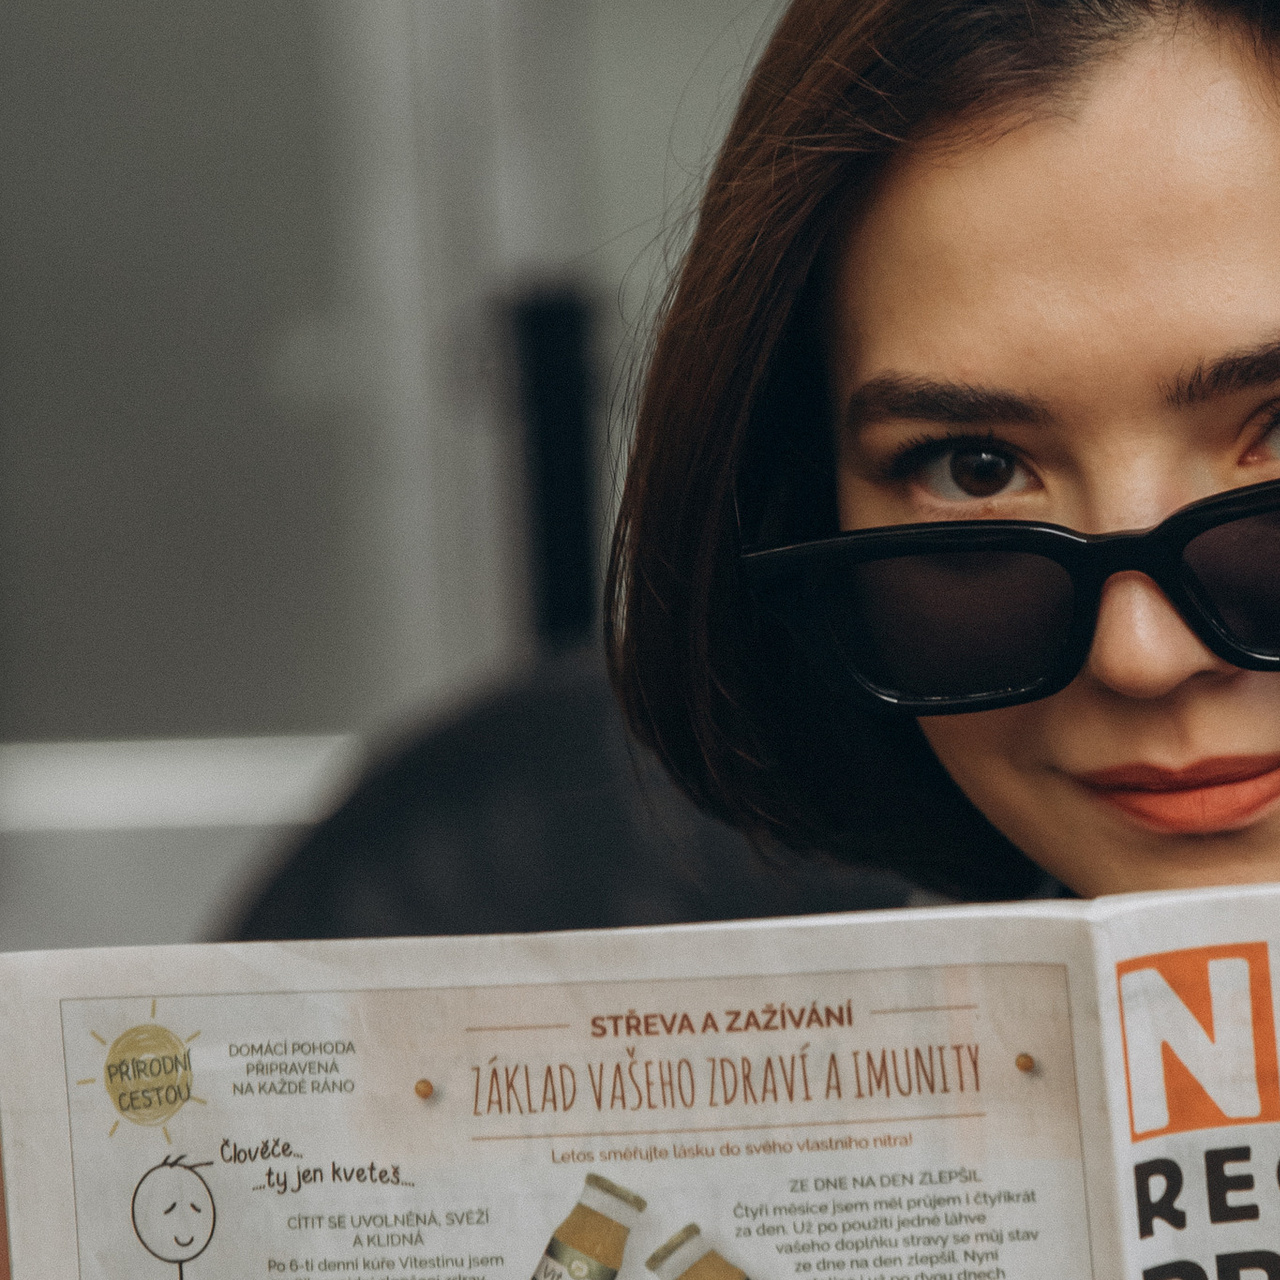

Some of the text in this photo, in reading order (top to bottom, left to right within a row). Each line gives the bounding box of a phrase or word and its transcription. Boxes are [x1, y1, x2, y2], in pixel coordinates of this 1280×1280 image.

[591, 1000, 852, 1037] STŘEVA A ZAŽÍVÁNÍ
[107, 1048, 192, 1083] PŘÍRODNÍ
[472, 1043, 980, 1116] ZÁKLAD VAŠEHO ZDRAVÍ A IMUNITY
[118, 1084, 192, 1112] CESTOU
[291, 1168, 323, 1193] jen
